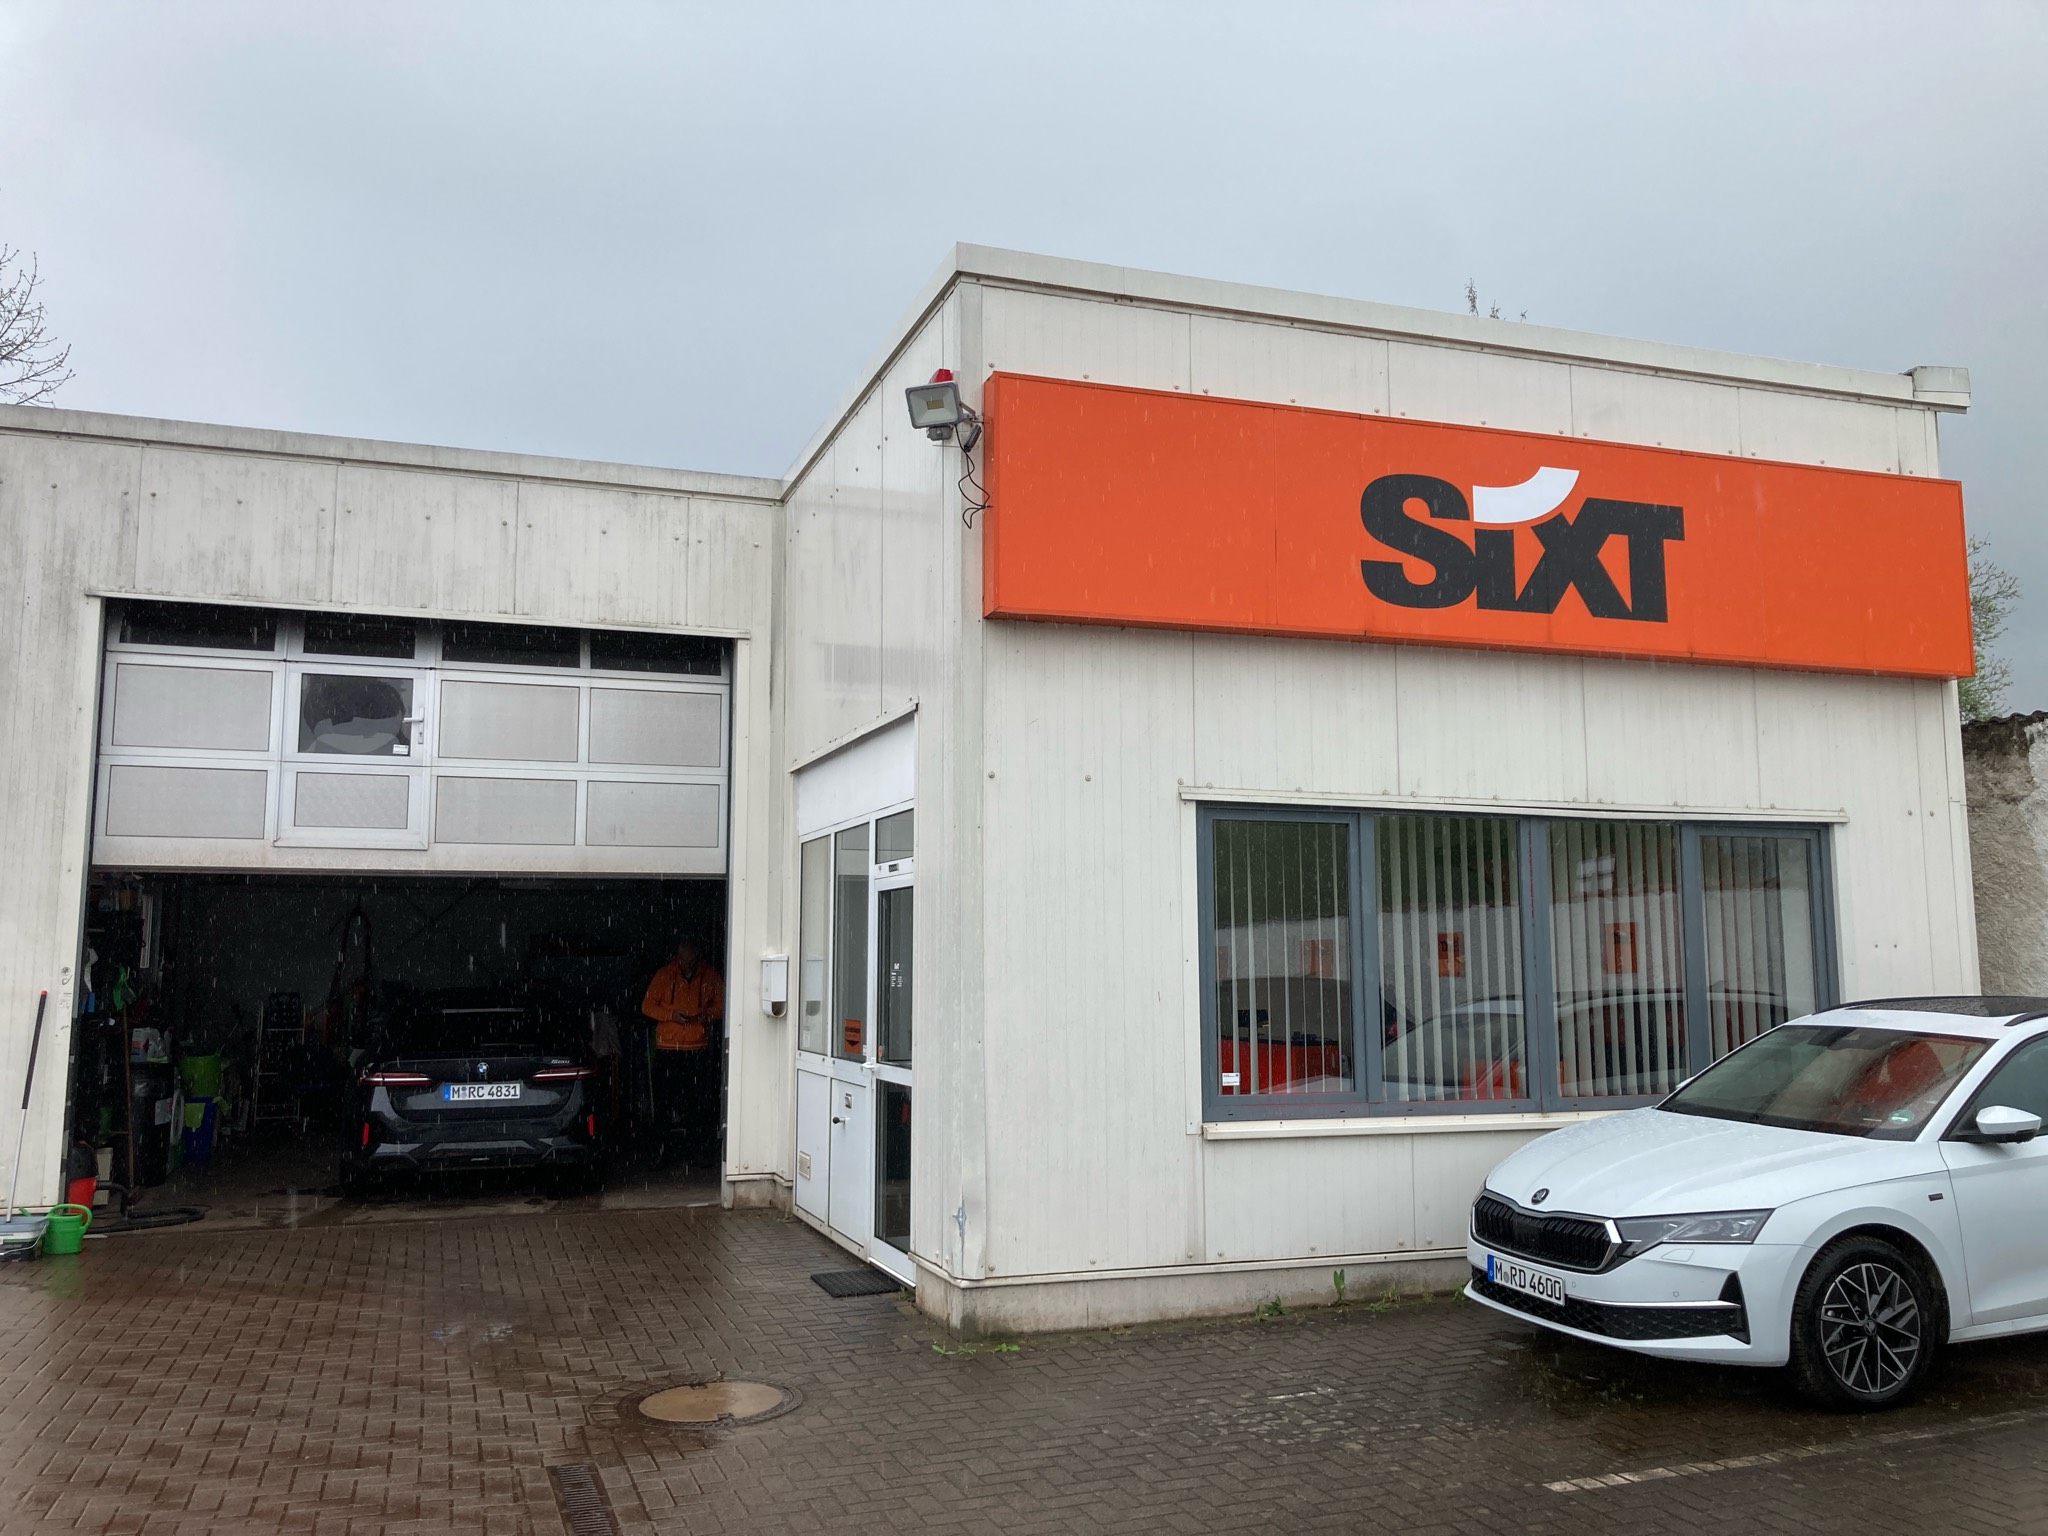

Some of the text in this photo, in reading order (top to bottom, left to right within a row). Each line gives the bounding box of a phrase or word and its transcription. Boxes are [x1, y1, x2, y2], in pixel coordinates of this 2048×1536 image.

[452, 1085, 518, 1098] M RC 4831
[1495, 1261, 1502, 1281] M
[1510, 1266, 1526, 1289] RD
[1529, 1273, 1561, 1300] 4600
